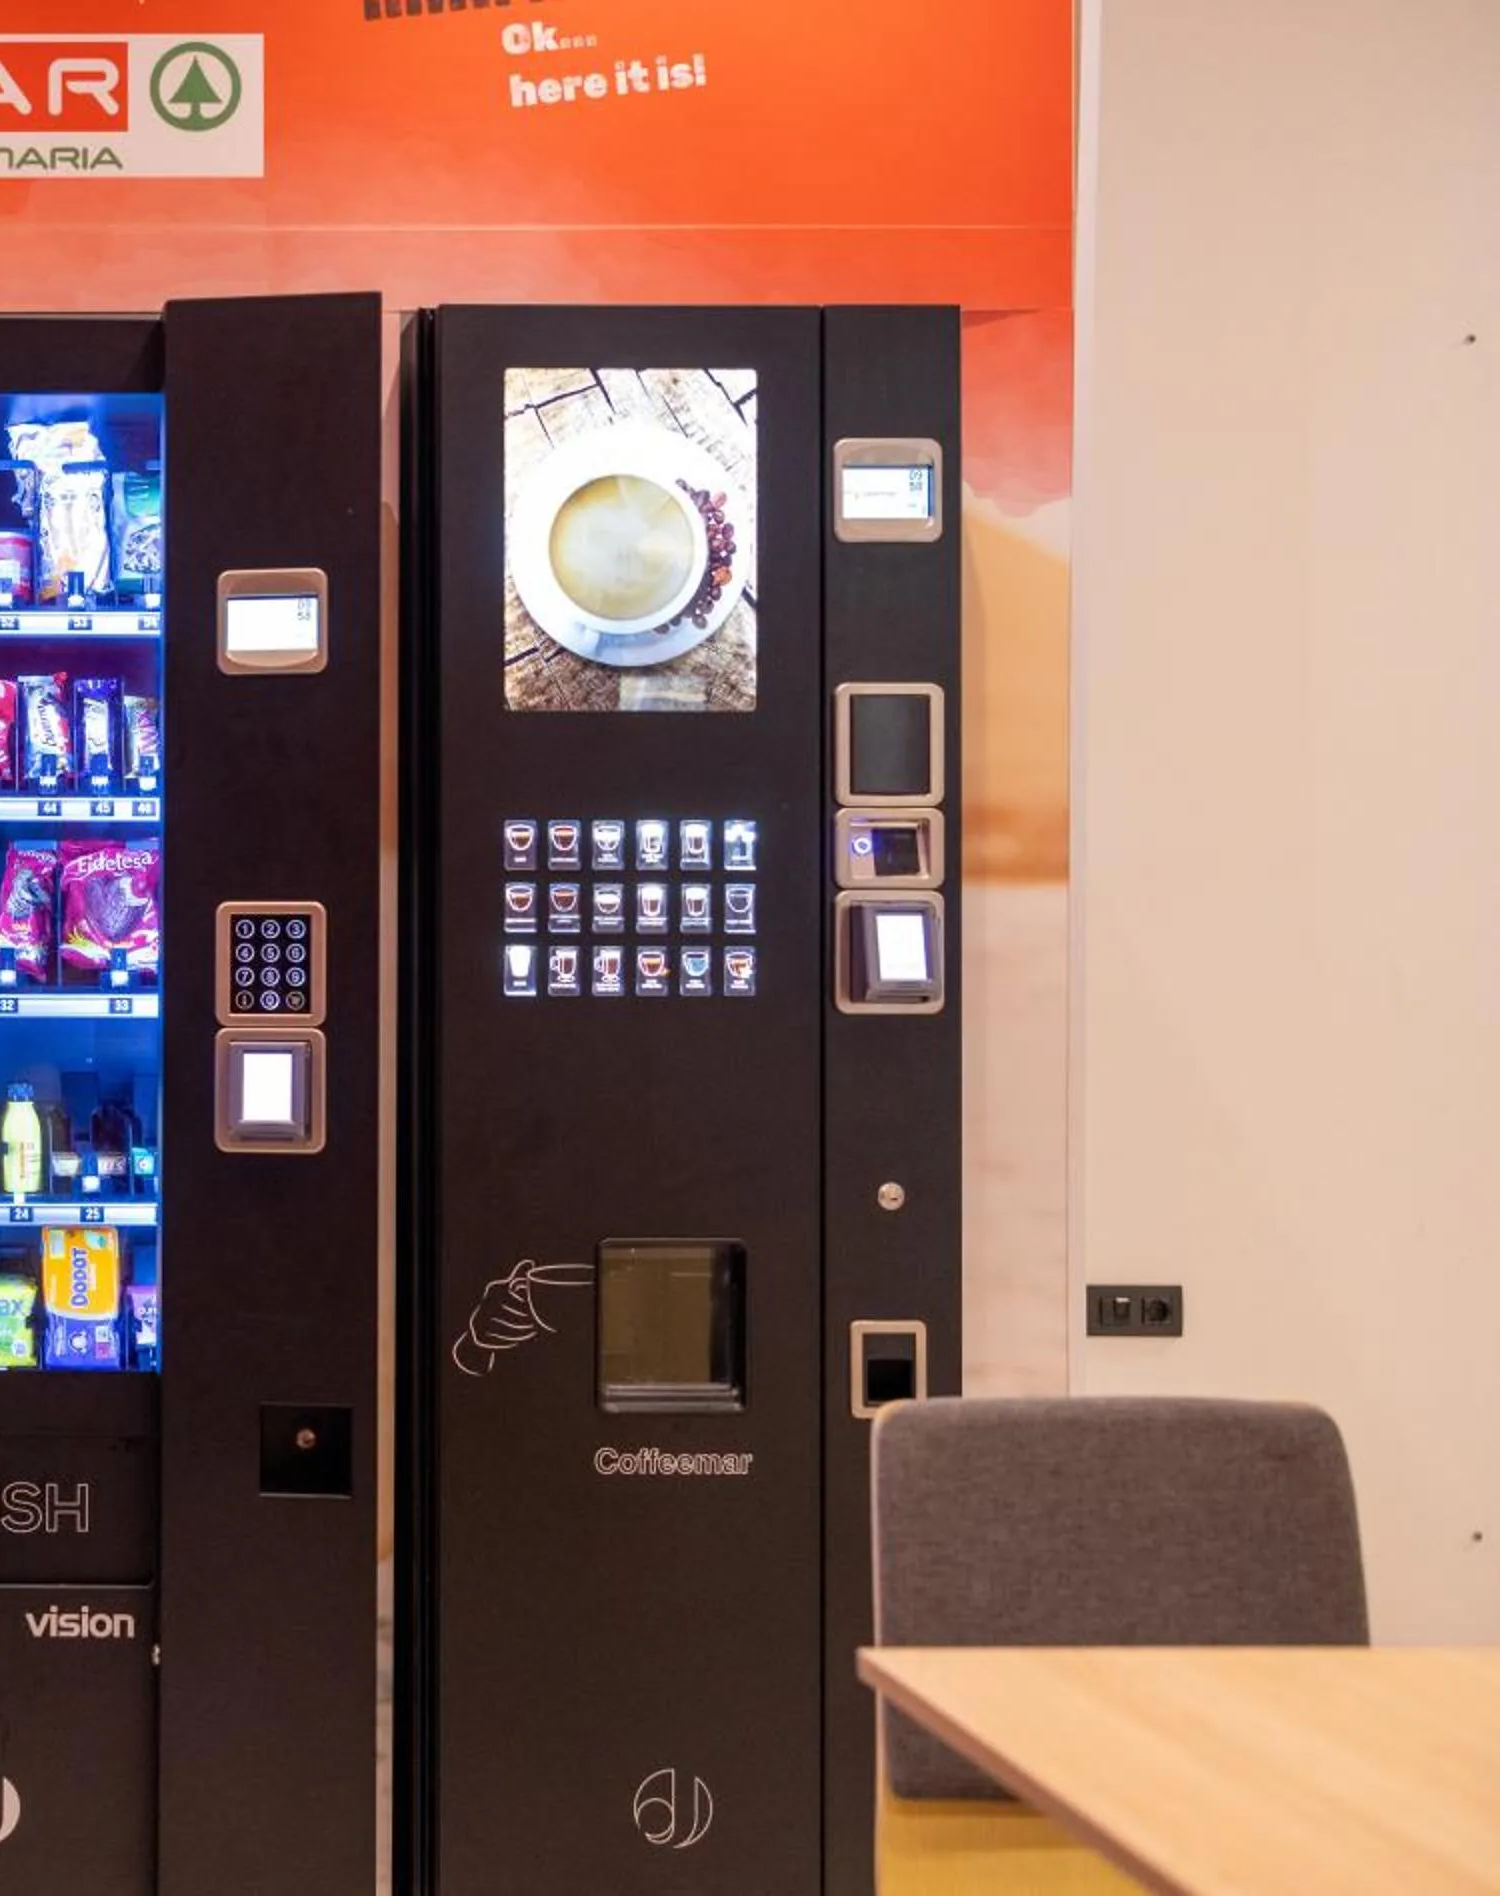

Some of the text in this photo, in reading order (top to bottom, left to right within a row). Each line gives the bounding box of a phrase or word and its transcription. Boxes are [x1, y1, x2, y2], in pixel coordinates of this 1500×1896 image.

[509, 53, 707, 108] here it is!
[594, 1447, 753, 1475] Coffeemar
[25, 1605, 135, 1638] vision
